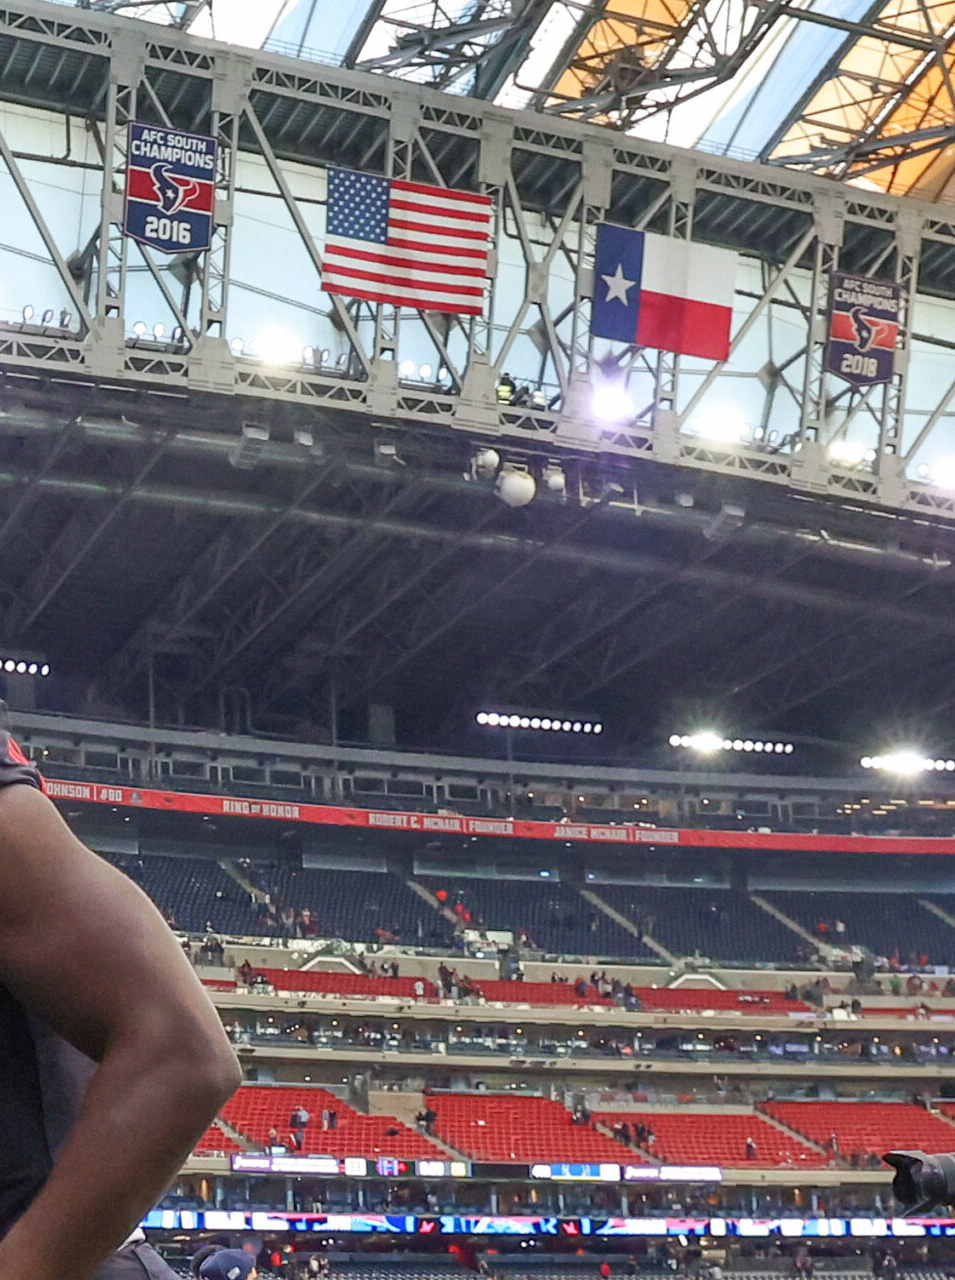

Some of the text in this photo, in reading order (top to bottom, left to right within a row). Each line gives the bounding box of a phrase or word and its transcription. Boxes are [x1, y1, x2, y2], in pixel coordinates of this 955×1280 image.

[141, 129, 207, 152] AFC SOUTH
[131, 140, 214, 169] CHAMPIONS
[144, 215, 192, 244] 2016
[841, 353, 878, 377] 2018
[45, 782, 91, 799] OHNSON
[223, 800, 250, 814] RING
[262, 804, 300, 818] HONOR
